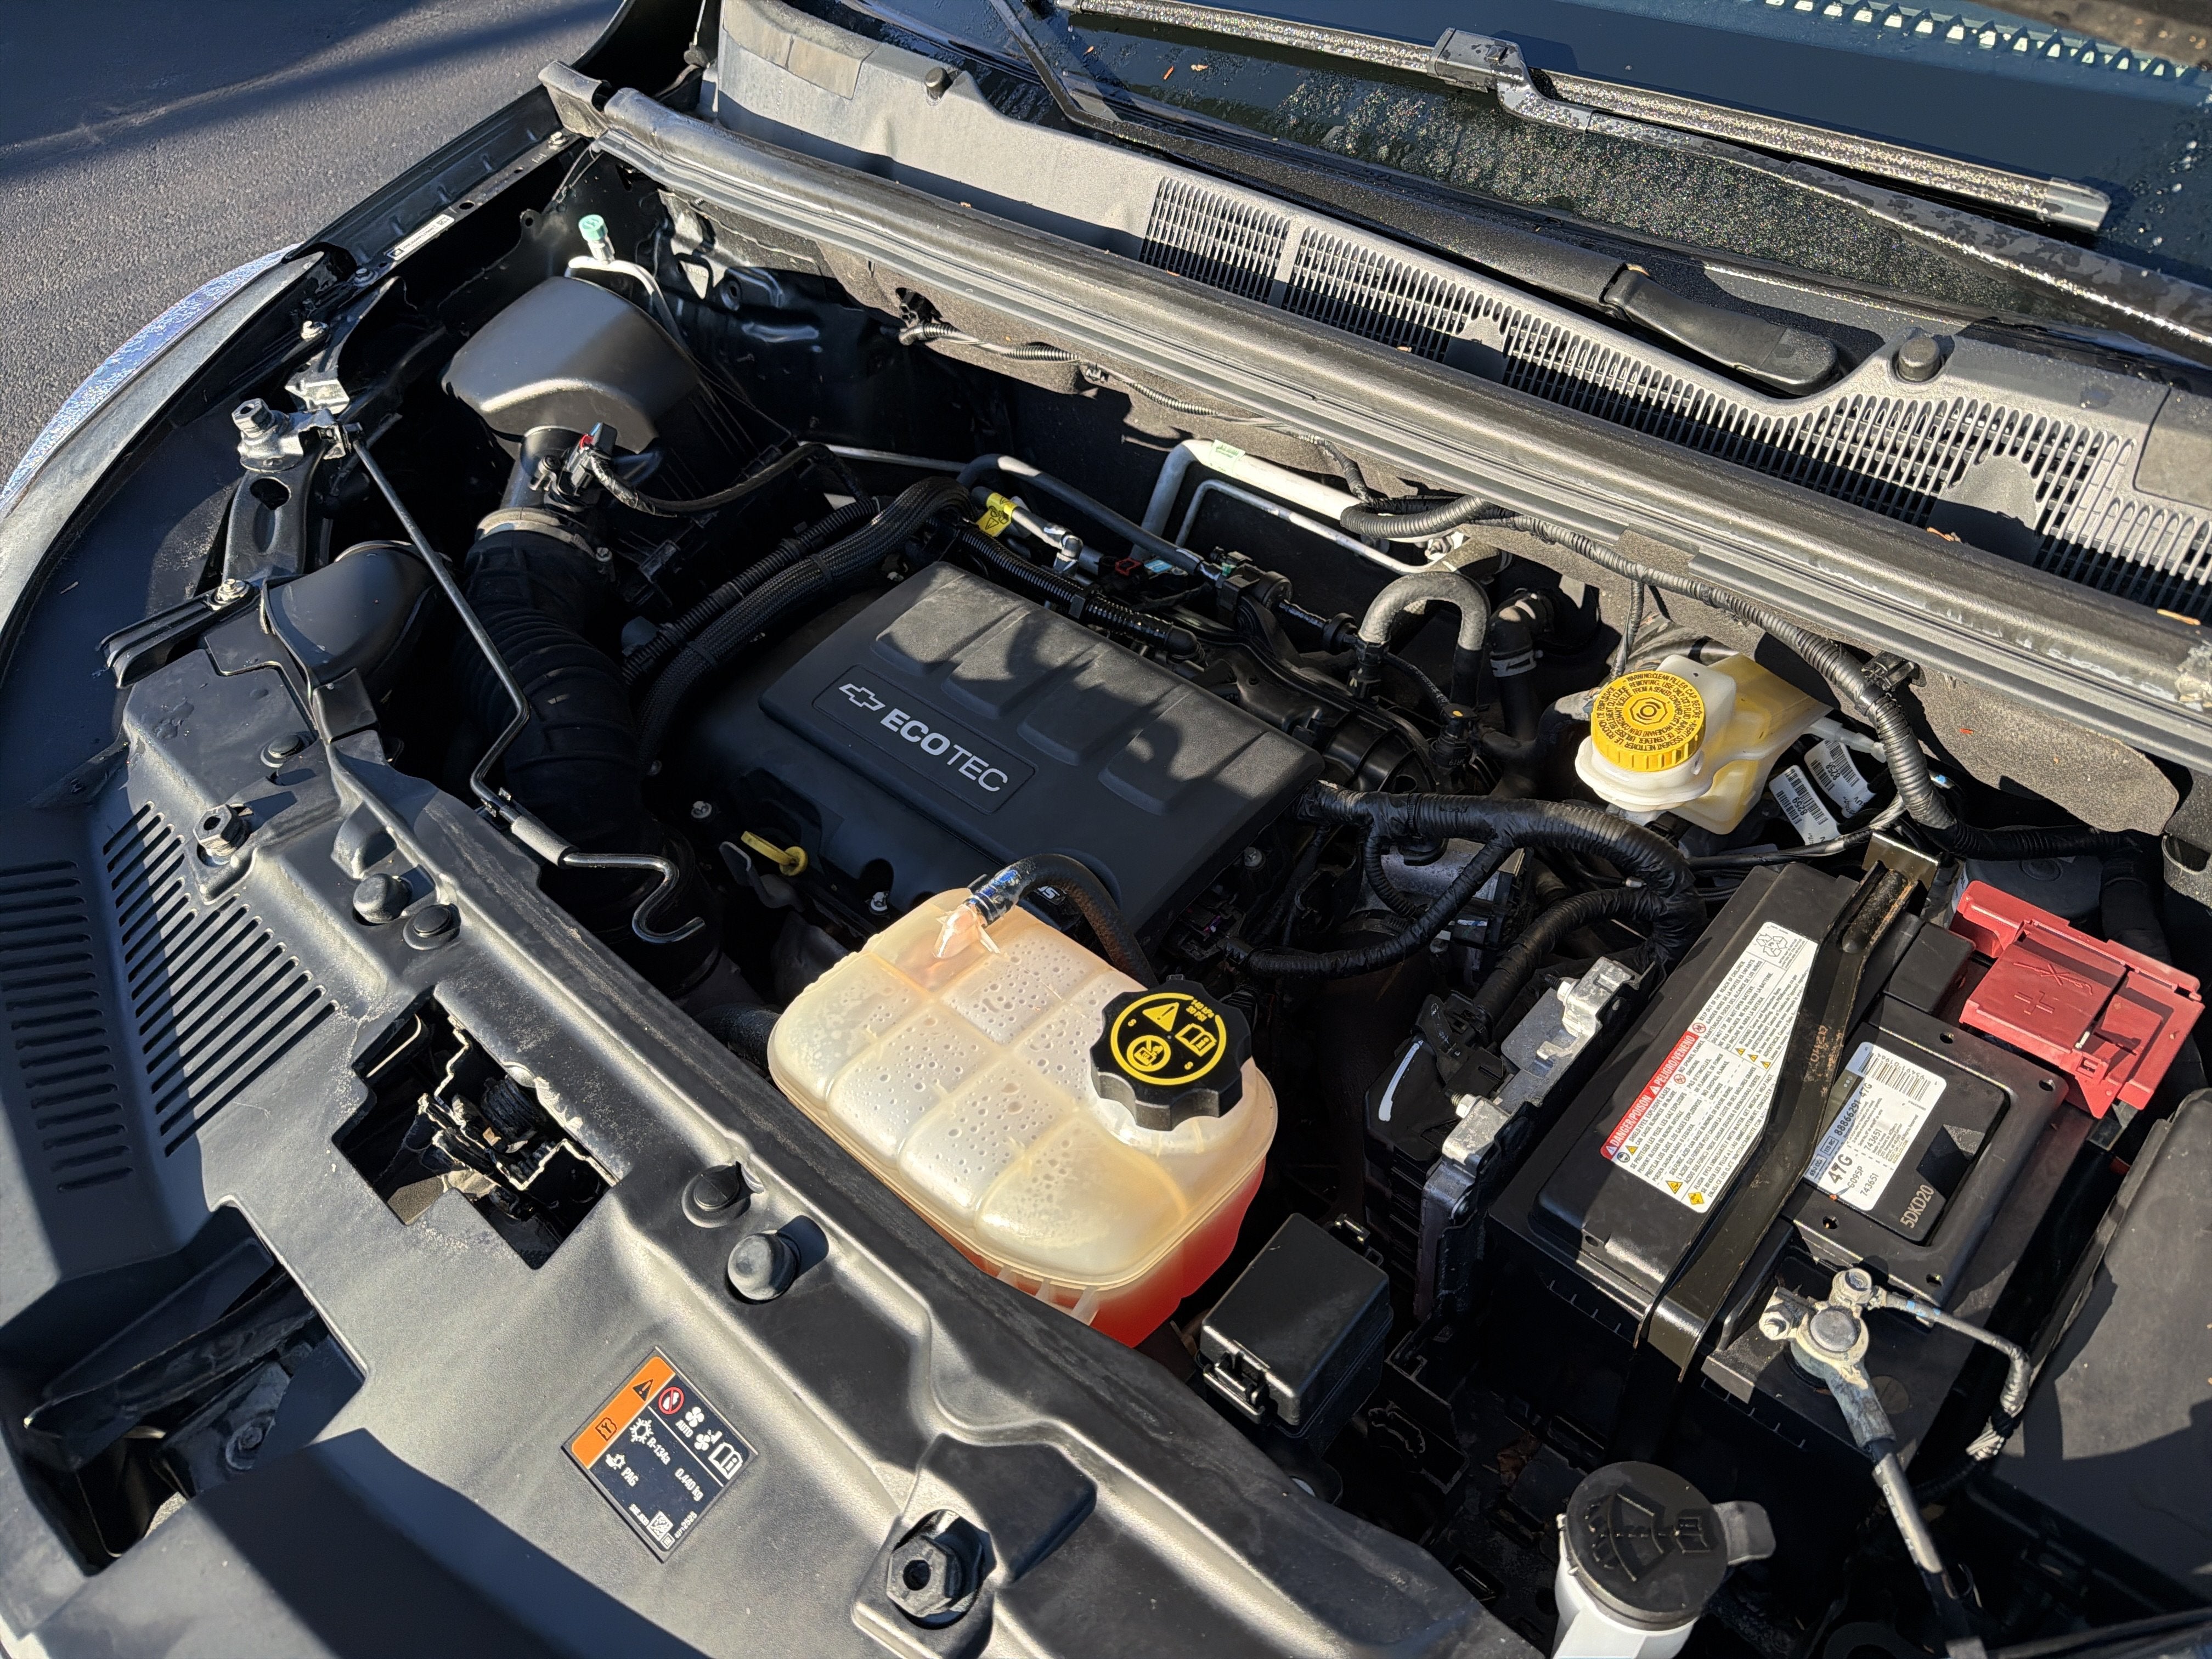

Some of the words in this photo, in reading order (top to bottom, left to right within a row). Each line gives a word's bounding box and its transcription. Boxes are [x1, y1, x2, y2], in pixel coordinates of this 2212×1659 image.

[881, 708, 1008, 792] ECOTEC
[1825, 762, 1841, 780] 8258
[1792, 797, 1808, 815] 8259
[1186, 1005, 1197, 1015] 20
[1194, 1011, 1207, 1022] PSI
[1191, 998, 1204, 1010] 140
[1654, 1034, 1695, 1086] PELIGRO/VENENO
[1834, 1099, 1860, 1135] 88866291
[1858, 1082, 1872, 1097] 47G
[1610, 1094, 1652, 1146] DANGER/POISON
[1864, 1128, 1881, 1150] 743651
[1826, 1154, 1852, 1184] 47G
[1860, 1173, 1878, 1196] 743651
[1900, 1184, 1933, 1228] 5DKD20
[675, 1419, 693, 1438] AUTO
[620, 1468, 639, 1486] PAG
[646, 1437, 672, 1464] R-134a
[674, 1468, 696, 1490] 0.440
[690, 1488, 704, 1502] kg
[628, 1503, 640, 1515] SAE
